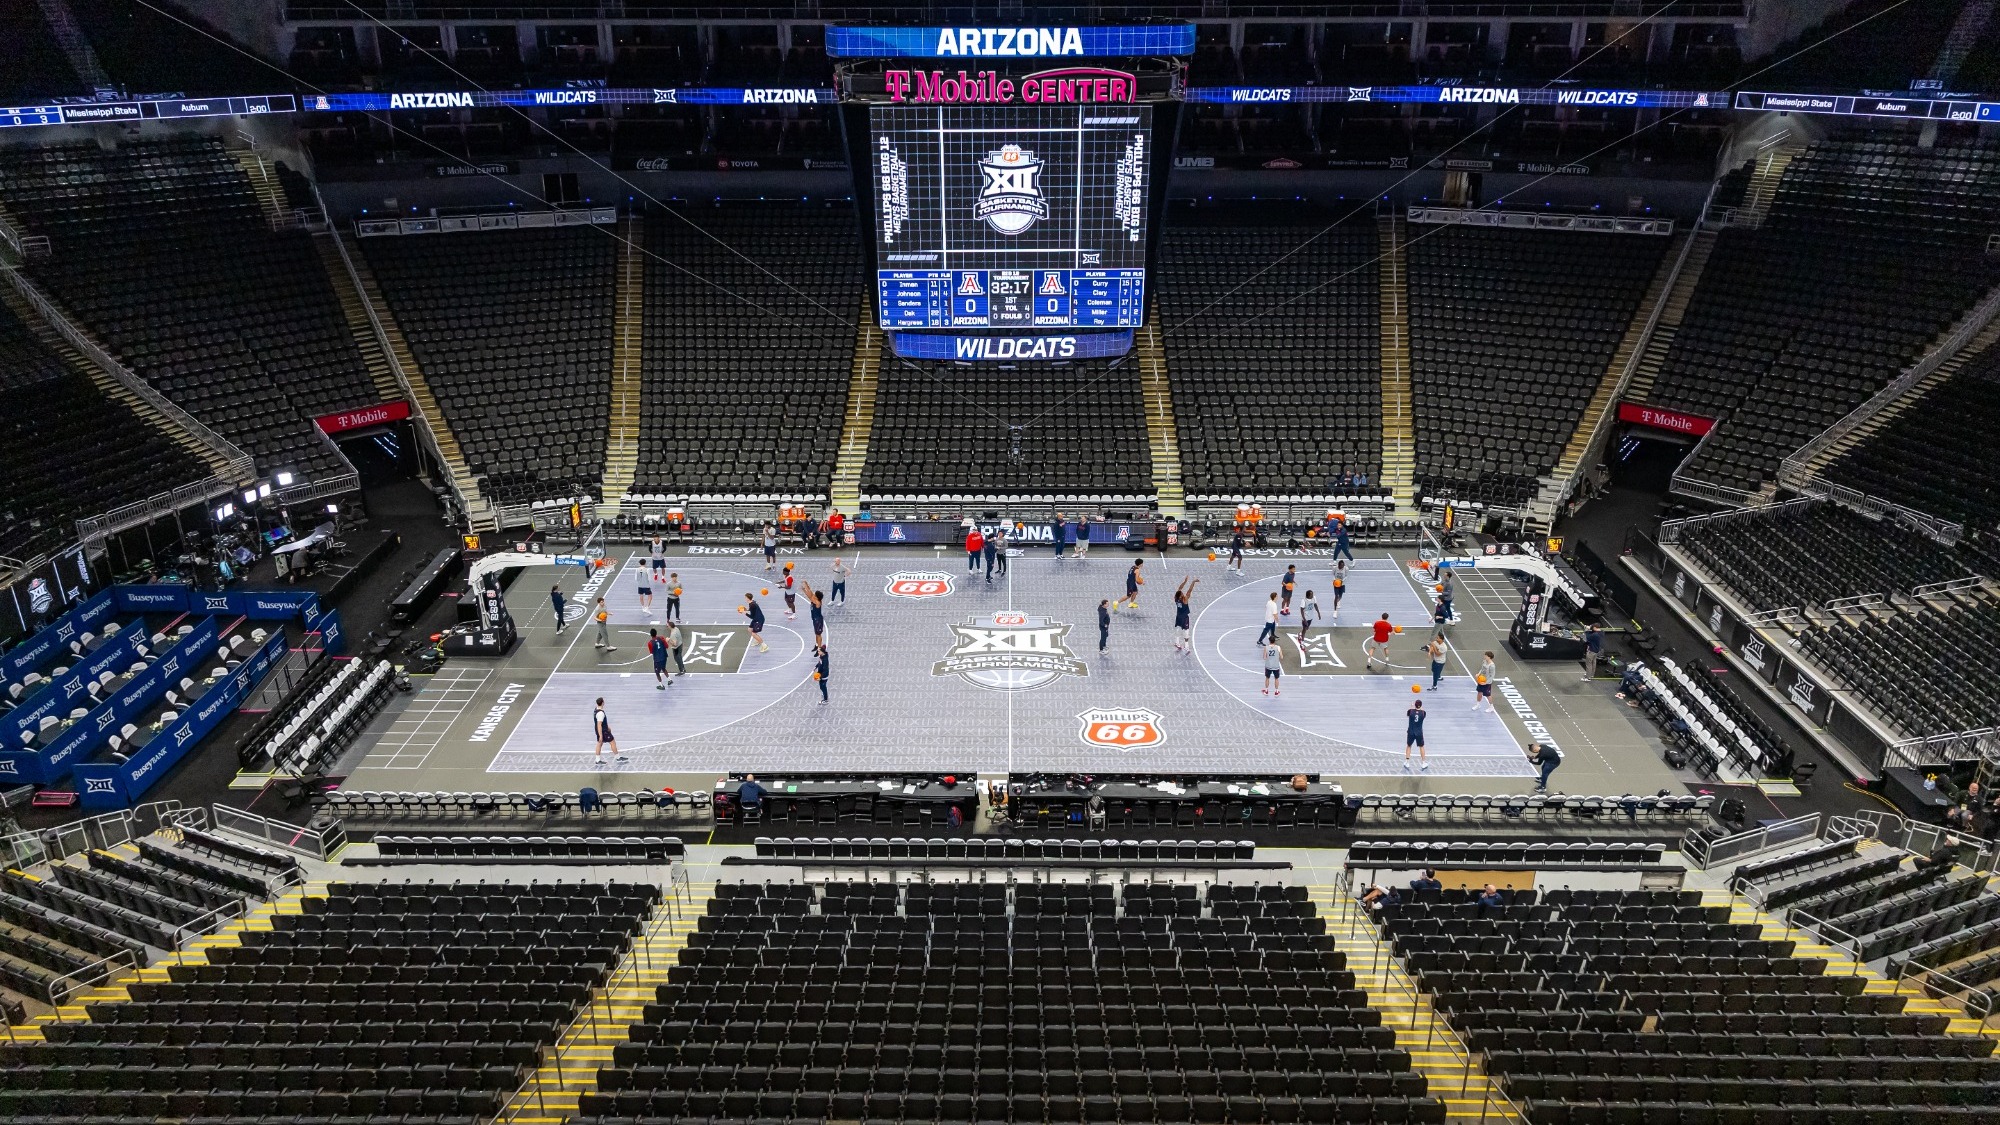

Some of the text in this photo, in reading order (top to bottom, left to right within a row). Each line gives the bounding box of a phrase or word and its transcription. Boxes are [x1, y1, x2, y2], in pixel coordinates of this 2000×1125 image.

[937, 28, 1084, 56] ARIZONA
[885, 70, 1127, 103] T Mobile CENTER
[390, 92, 474, 108] ARIZONA
[536, 91, 596, 104] WILDCATS
[743, 89, 818, 103] ARIZONA
[1232, 89, 1291, 101] WILDCATS
[1439, 88, 1519, 103] ARIZONA
[1558, 92, 1638, 104] WILDCATS
[181, 103, 208, 112] Auburn
[1767, 97, 1832, 108] Mississippi State
[1876, 102, 1906, 112] Auburn
[66, 106, 137, 118] Mississippi State
[1952, 111, 1972, 120] 2:00
[14, 116, 48, 125] 0 3
[1174, 158, 1214, 167] UMB
[1527, 164, 1555, 173] Mobile
[447, 166, 475, 175] Mobile
[983, 166, 1039, 197] XII
[1122, 145, 1134, 231] MEN'S BASKETBALL
[1130, 134, 1144, 242] PHILLIPS 66 BIG 12
[880, 137, 894, 244] PHILLIPS 66 BIG 12
[890, 148, 901, 234] MEN'S BASKETBALL
[898, 160, 908, 221] TOURNAMENT
[1115, 159, 1125, 220] TOURNAMENT
[978, 204, 1044, 215] TOURNAMENT
[980, 198, 1042, 208] BASKETBALL
[991, 282, 1030, 294] 32:17
[966, 299, 976, 313] 0
[1048, 298, 1058, 312] 0
[956, 338, 1076, 358] WILDCATS
[338, 410, 388, 427] T Mobile
[1642, 411, 1692, 430] T Mobile
[899, 582, 940, 593] 66
[954, 628, 1066, 654] XII
[940, 662, 1079, 672] TOURNAMENT
[946, 655, 1074, 666] BASKETBALL
[1496, 677, 1537, 718] T-MOBILE
[469, 683, 525, 742] KANSAS CITY
[1096, 724, 1147, 740] 66
